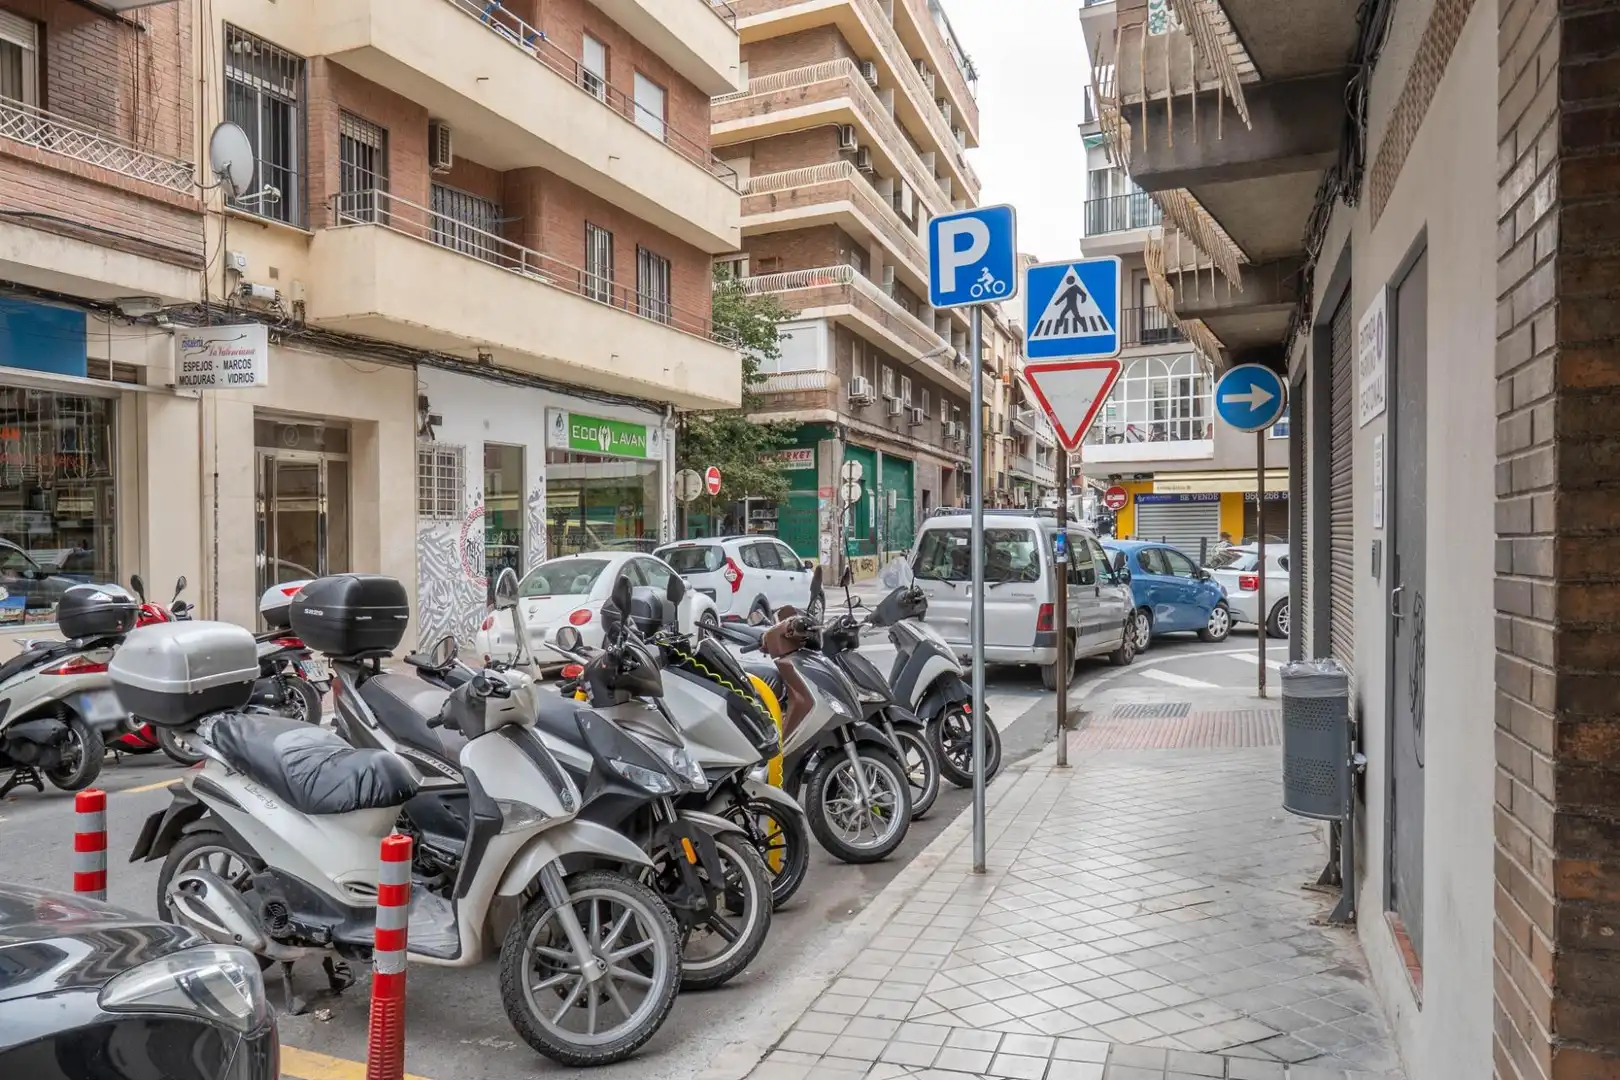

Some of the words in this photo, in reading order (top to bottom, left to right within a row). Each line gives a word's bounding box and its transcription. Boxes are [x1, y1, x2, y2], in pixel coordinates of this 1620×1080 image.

[938, 217, 990, 293] P
[183, 360, 213, 372] ESPEJOS
[223, 359, 252, 370] MARCOS
[179, 374, 215, 386] MOLDURAS
[228, 372, 255, 384] VIDRIOS
[572, 425, 597, 441] ECO
[1192, 492, 1219, 501] VENDE
